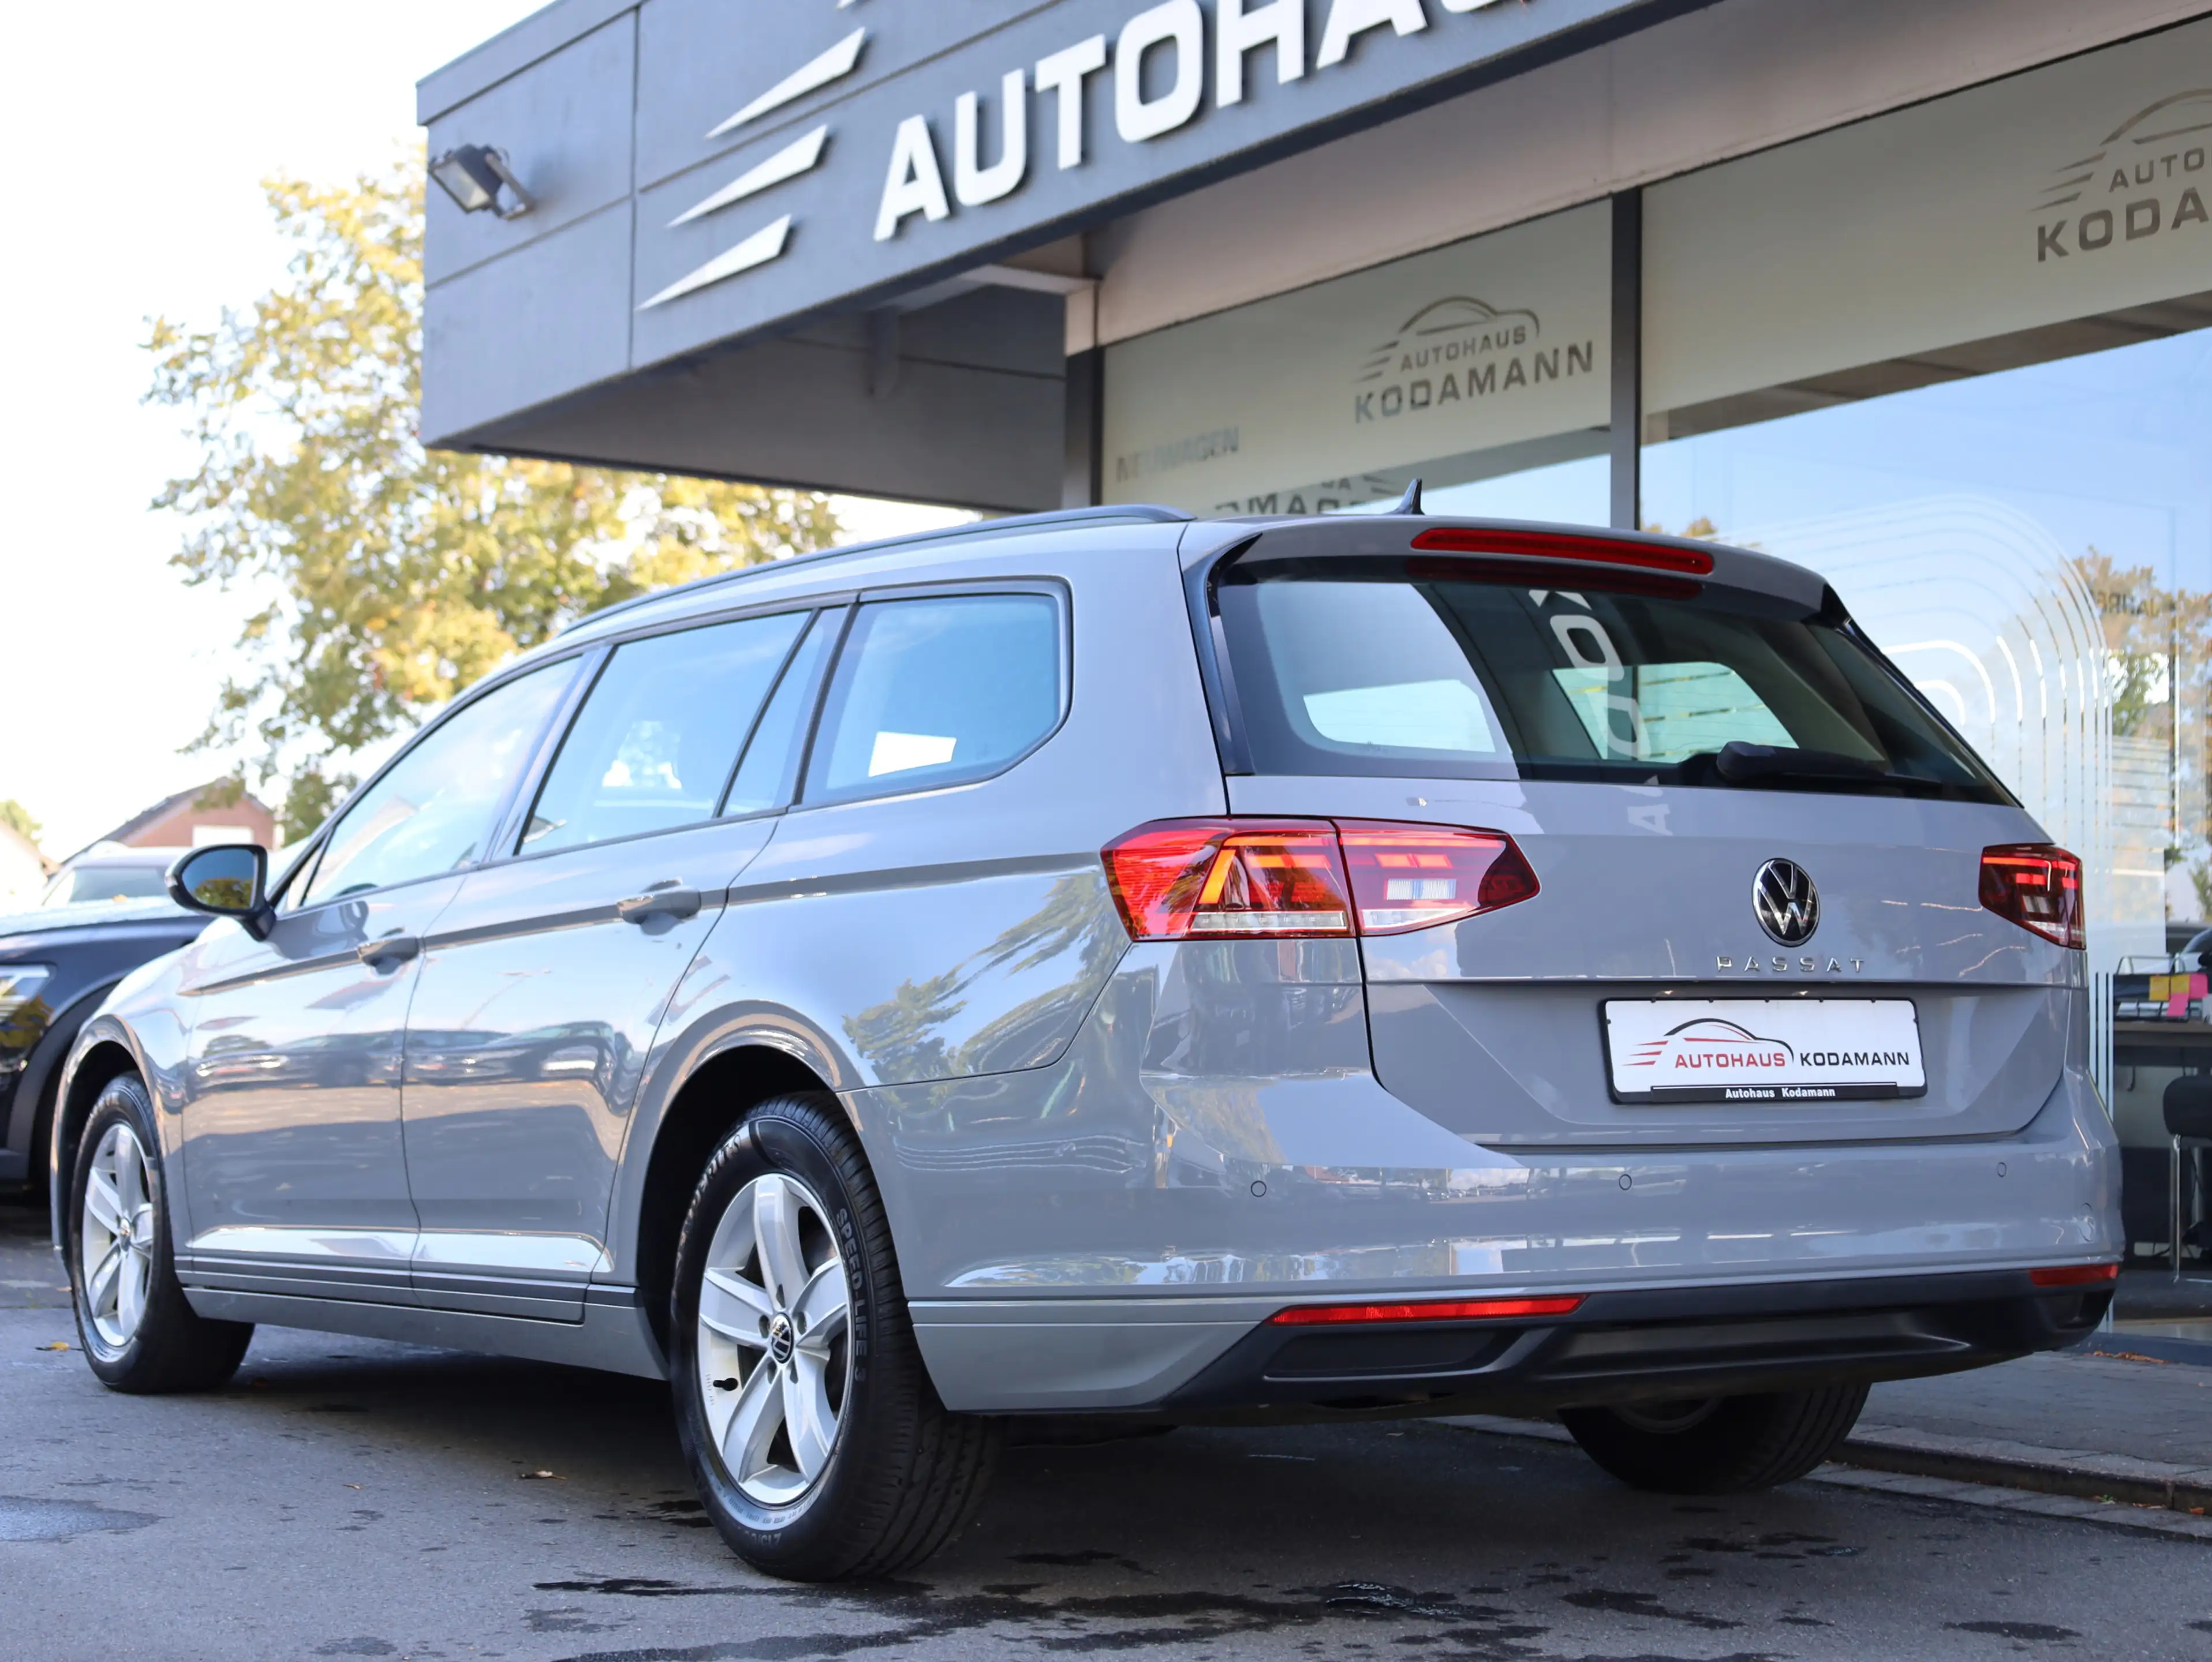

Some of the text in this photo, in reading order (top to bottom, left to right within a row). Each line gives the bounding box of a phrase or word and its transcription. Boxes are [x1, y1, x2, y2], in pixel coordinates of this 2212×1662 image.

[873, 0, 1497, 241] AUTOH
[2109, 145, 2212, 193] AUTO
[1400, 325, 1527, 372] AUTOHAUS
[1355, 340, 1593, 423] KODAMANN
[1716, 956, 1864, 972] PASSAT
[1675, 1051, 1910, 1068] AUTOHAUS KODAMANN
[1725, 1087, 1836, 1099] Autohaus Kodamann
[836, 1207, 868, 1356] SPEED-LIFE
